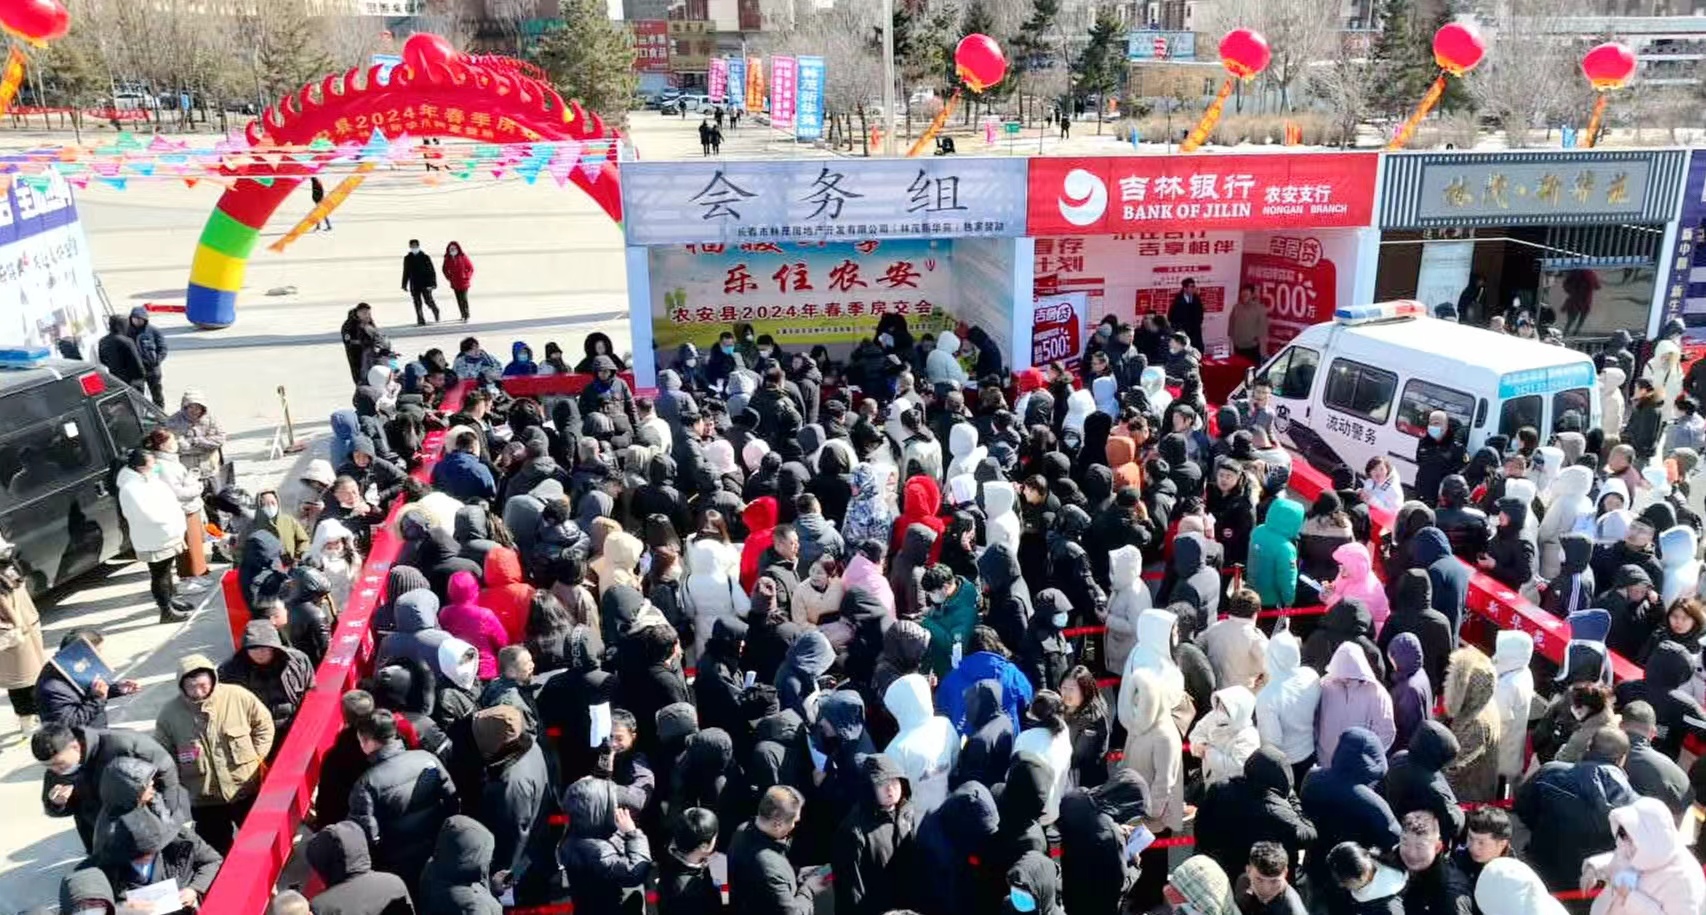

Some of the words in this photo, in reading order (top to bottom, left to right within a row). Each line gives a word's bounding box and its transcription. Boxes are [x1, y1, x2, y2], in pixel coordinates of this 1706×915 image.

[689, 168, 969, 221] 会务组
[1119, 173, 1256, 203] 吉林银行
[1264, 185, 1332, 204] 农安支行
[1122, 204, 1172, 220] BANK
[1176, 203, 1200, 218] OF
[1202, 202, 1251, 218] JILIN
[1262, 206, 1303, 216] NONGAN
[1310, 203, 1348, 214] BRANCH
[723, 261, 922, 295] 乐住农安
[672, 299, 933, 323] 农安县2024年春季房交会
[1326, 414, 1377, 445] 流动警务
